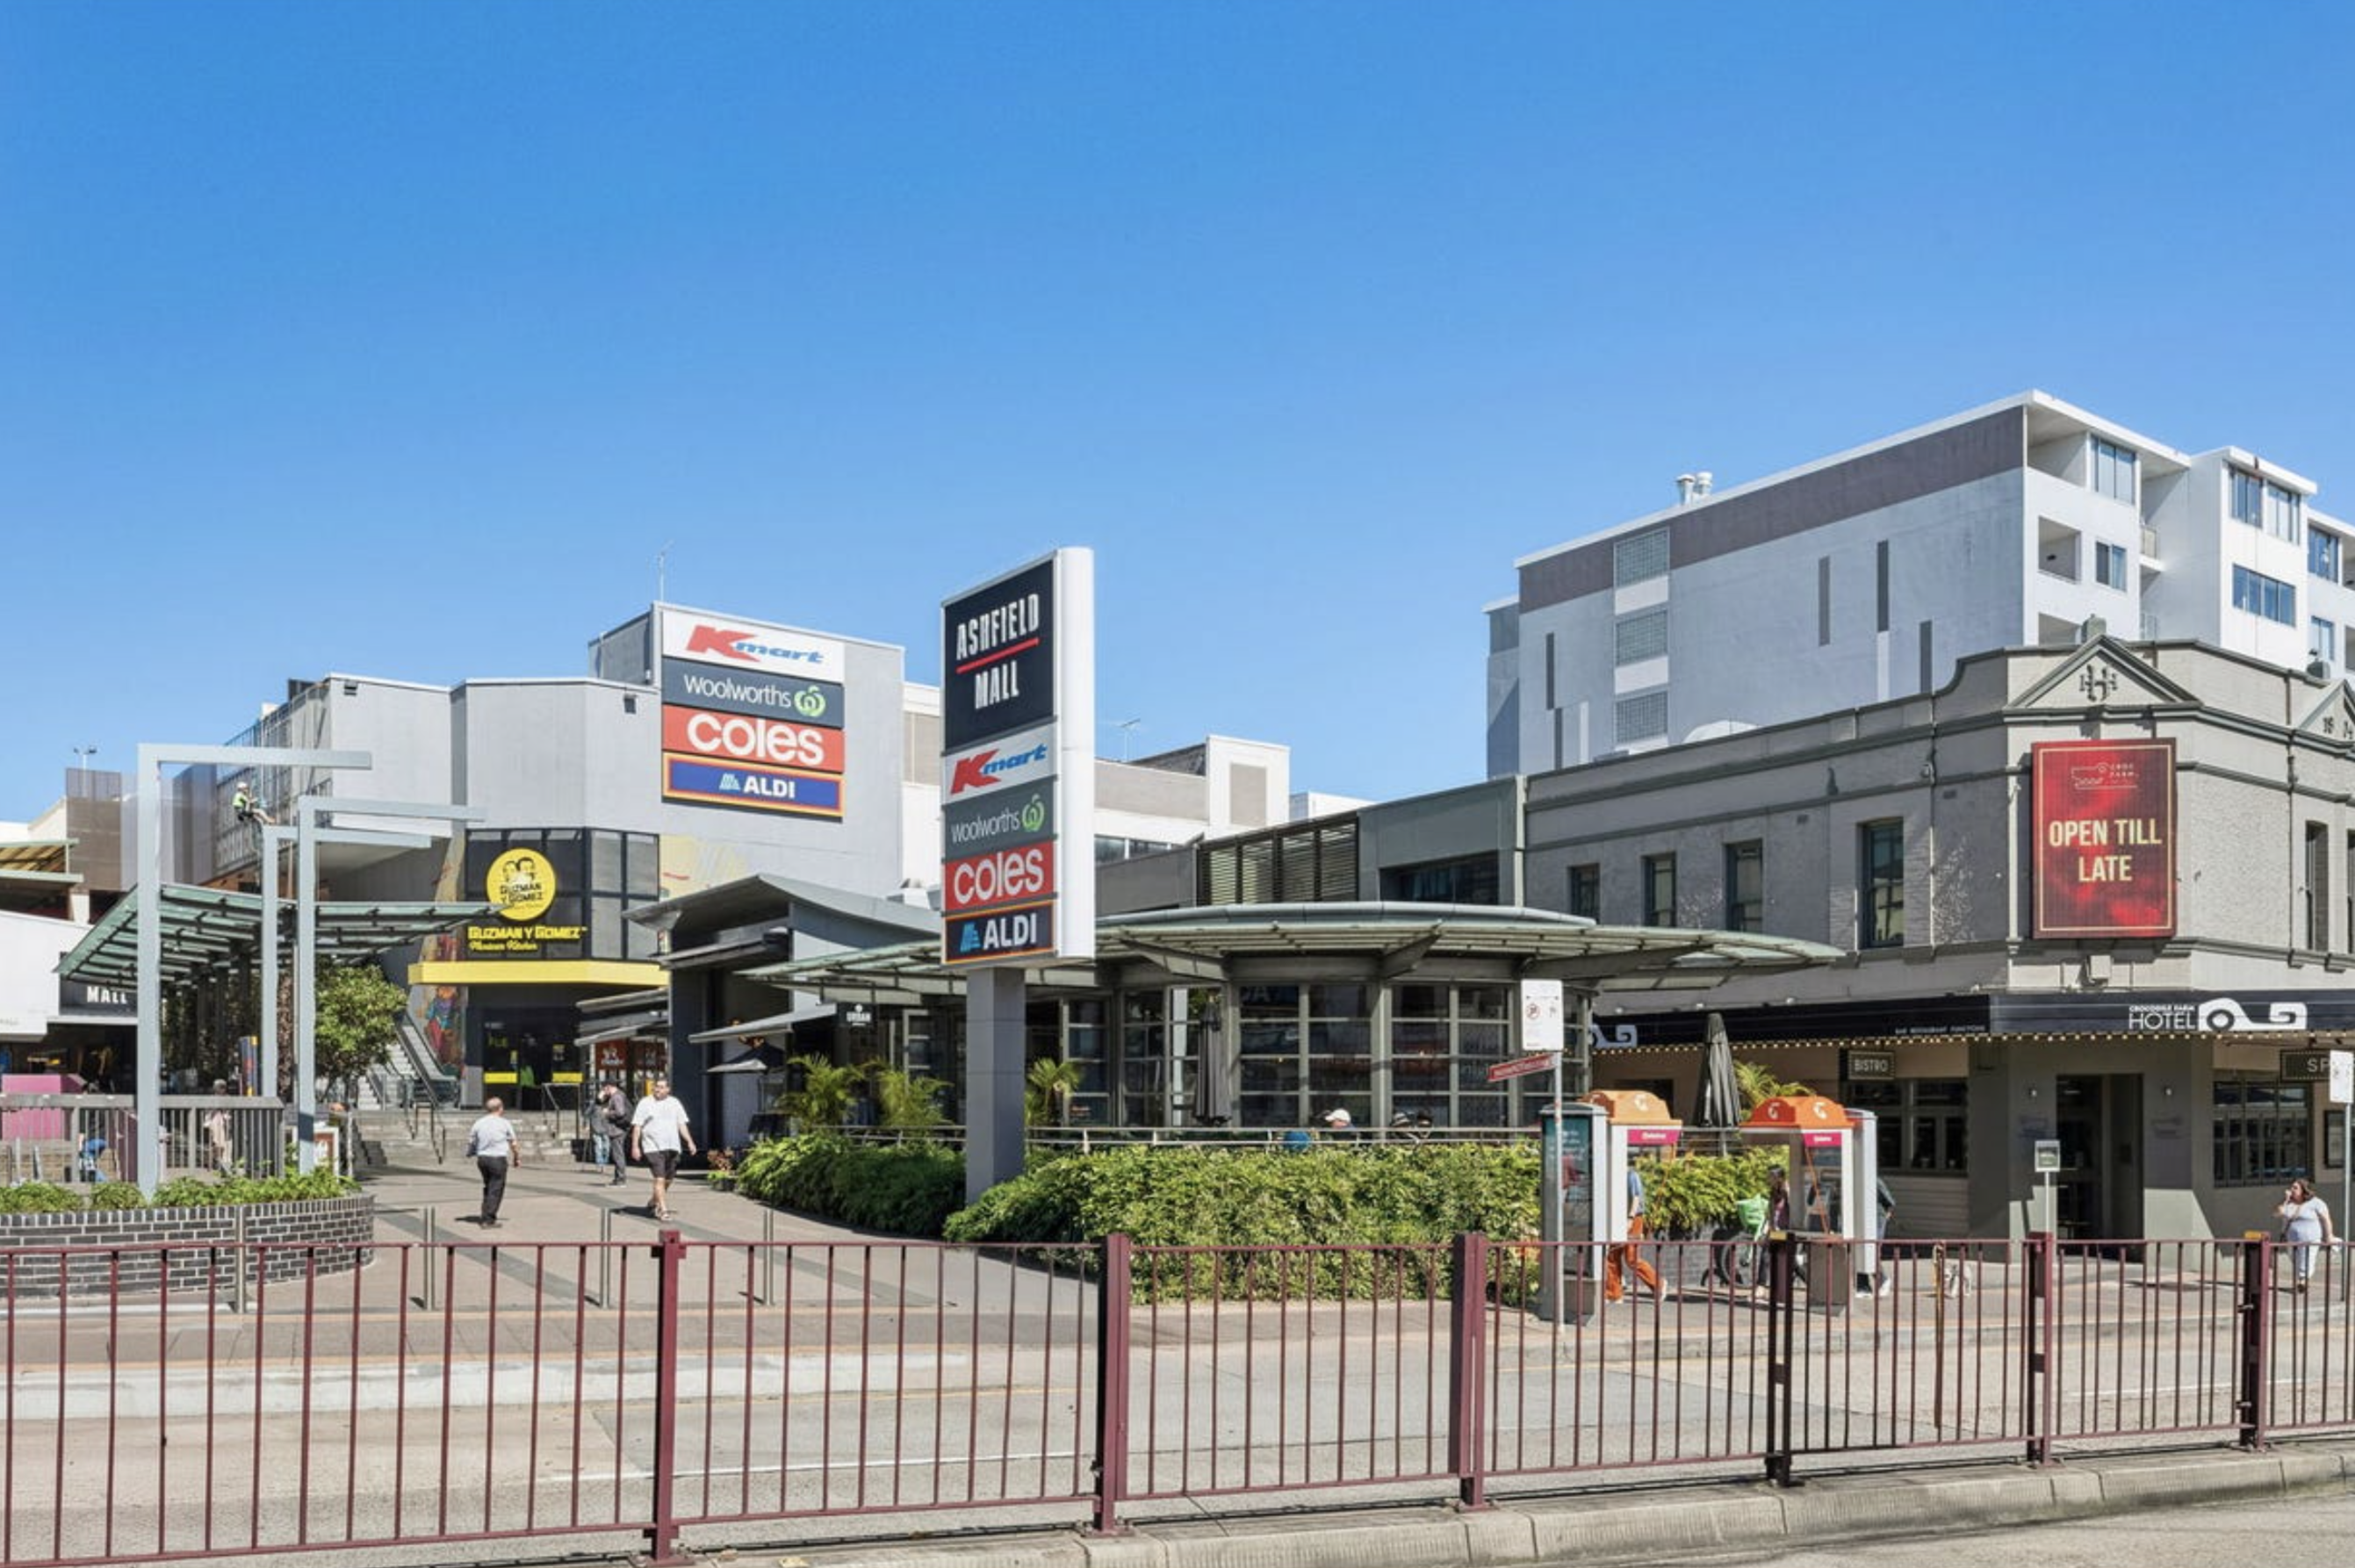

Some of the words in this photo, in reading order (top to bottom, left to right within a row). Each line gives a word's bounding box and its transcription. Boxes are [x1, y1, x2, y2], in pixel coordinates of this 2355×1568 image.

[686, 623, 825, 663] Kmart
[956, 593, 1040, 661] ASHFIELD
[683, 673, 792, 708] Woolworths
[975, 660, 1019, 709] MALL
[687, 712, 825, 766] coles
[743, 774, 796, 798] ALDI
[950, 744, 1048, 795] Kmart
[951, 807, 1020, 843] Woolworths
[2049, 819, 2108, 847] OPEN
[2114, 818, 2163, 845] TILL
[954, 848, 1045, 913] coles
[2078, 855, 2133, 882] LATE
[468, 926, 523, 939] GUZMAN
[524, 926, 533, 939] Y
[983, 913, 1037, 951] ALDI
[87, 985, 127, 1004] MALL
[2128, 1012, 2196, 1030] HOTEL
[1854, 1059, 1889, 1072] BISTRO
